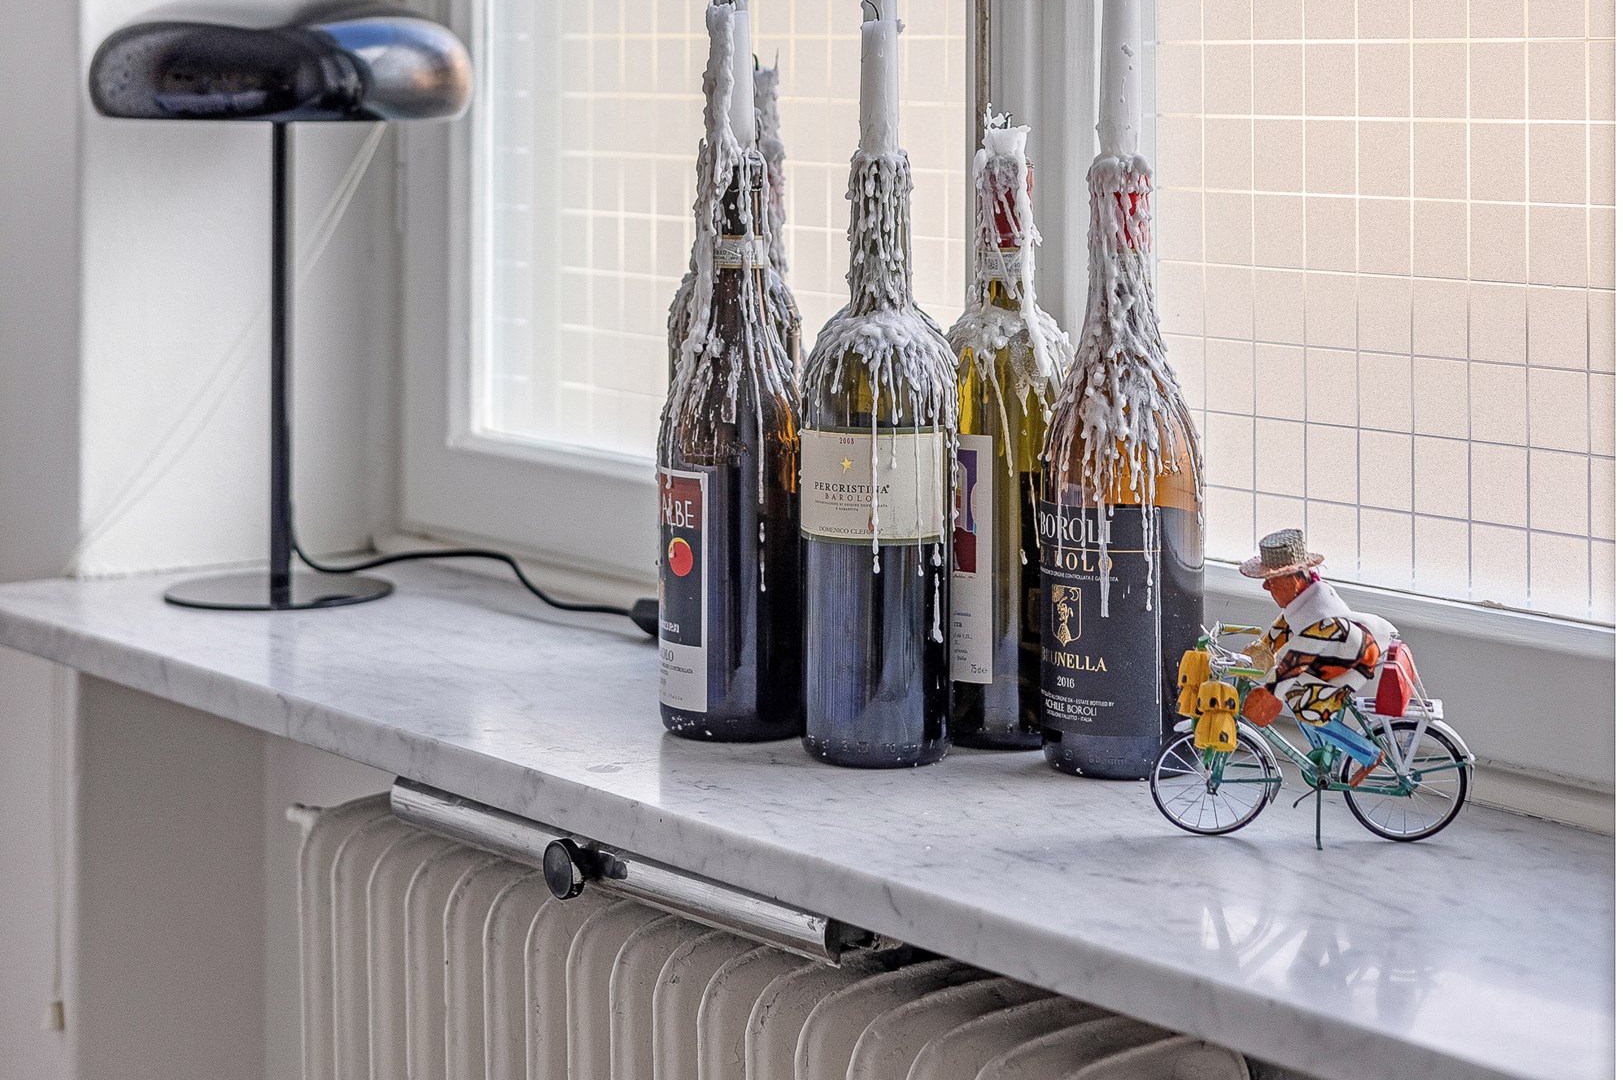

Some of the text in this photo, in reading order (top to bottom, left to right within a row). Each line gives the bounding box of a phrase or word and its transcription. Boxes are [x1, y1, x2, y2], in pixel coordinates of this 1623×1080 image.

[839, 437, 855, 445] 2008
[824, 493, 872, 502] BAROLO
[818, 525, 850, 535] DOMENICO
[1040, 510, 1113, 544] BOROLI
[1040, 545, 1113, 572] BROLO
[1056, 675, 1075, 689] 2016
[1066, 704, 1097, 717] BOROLI
